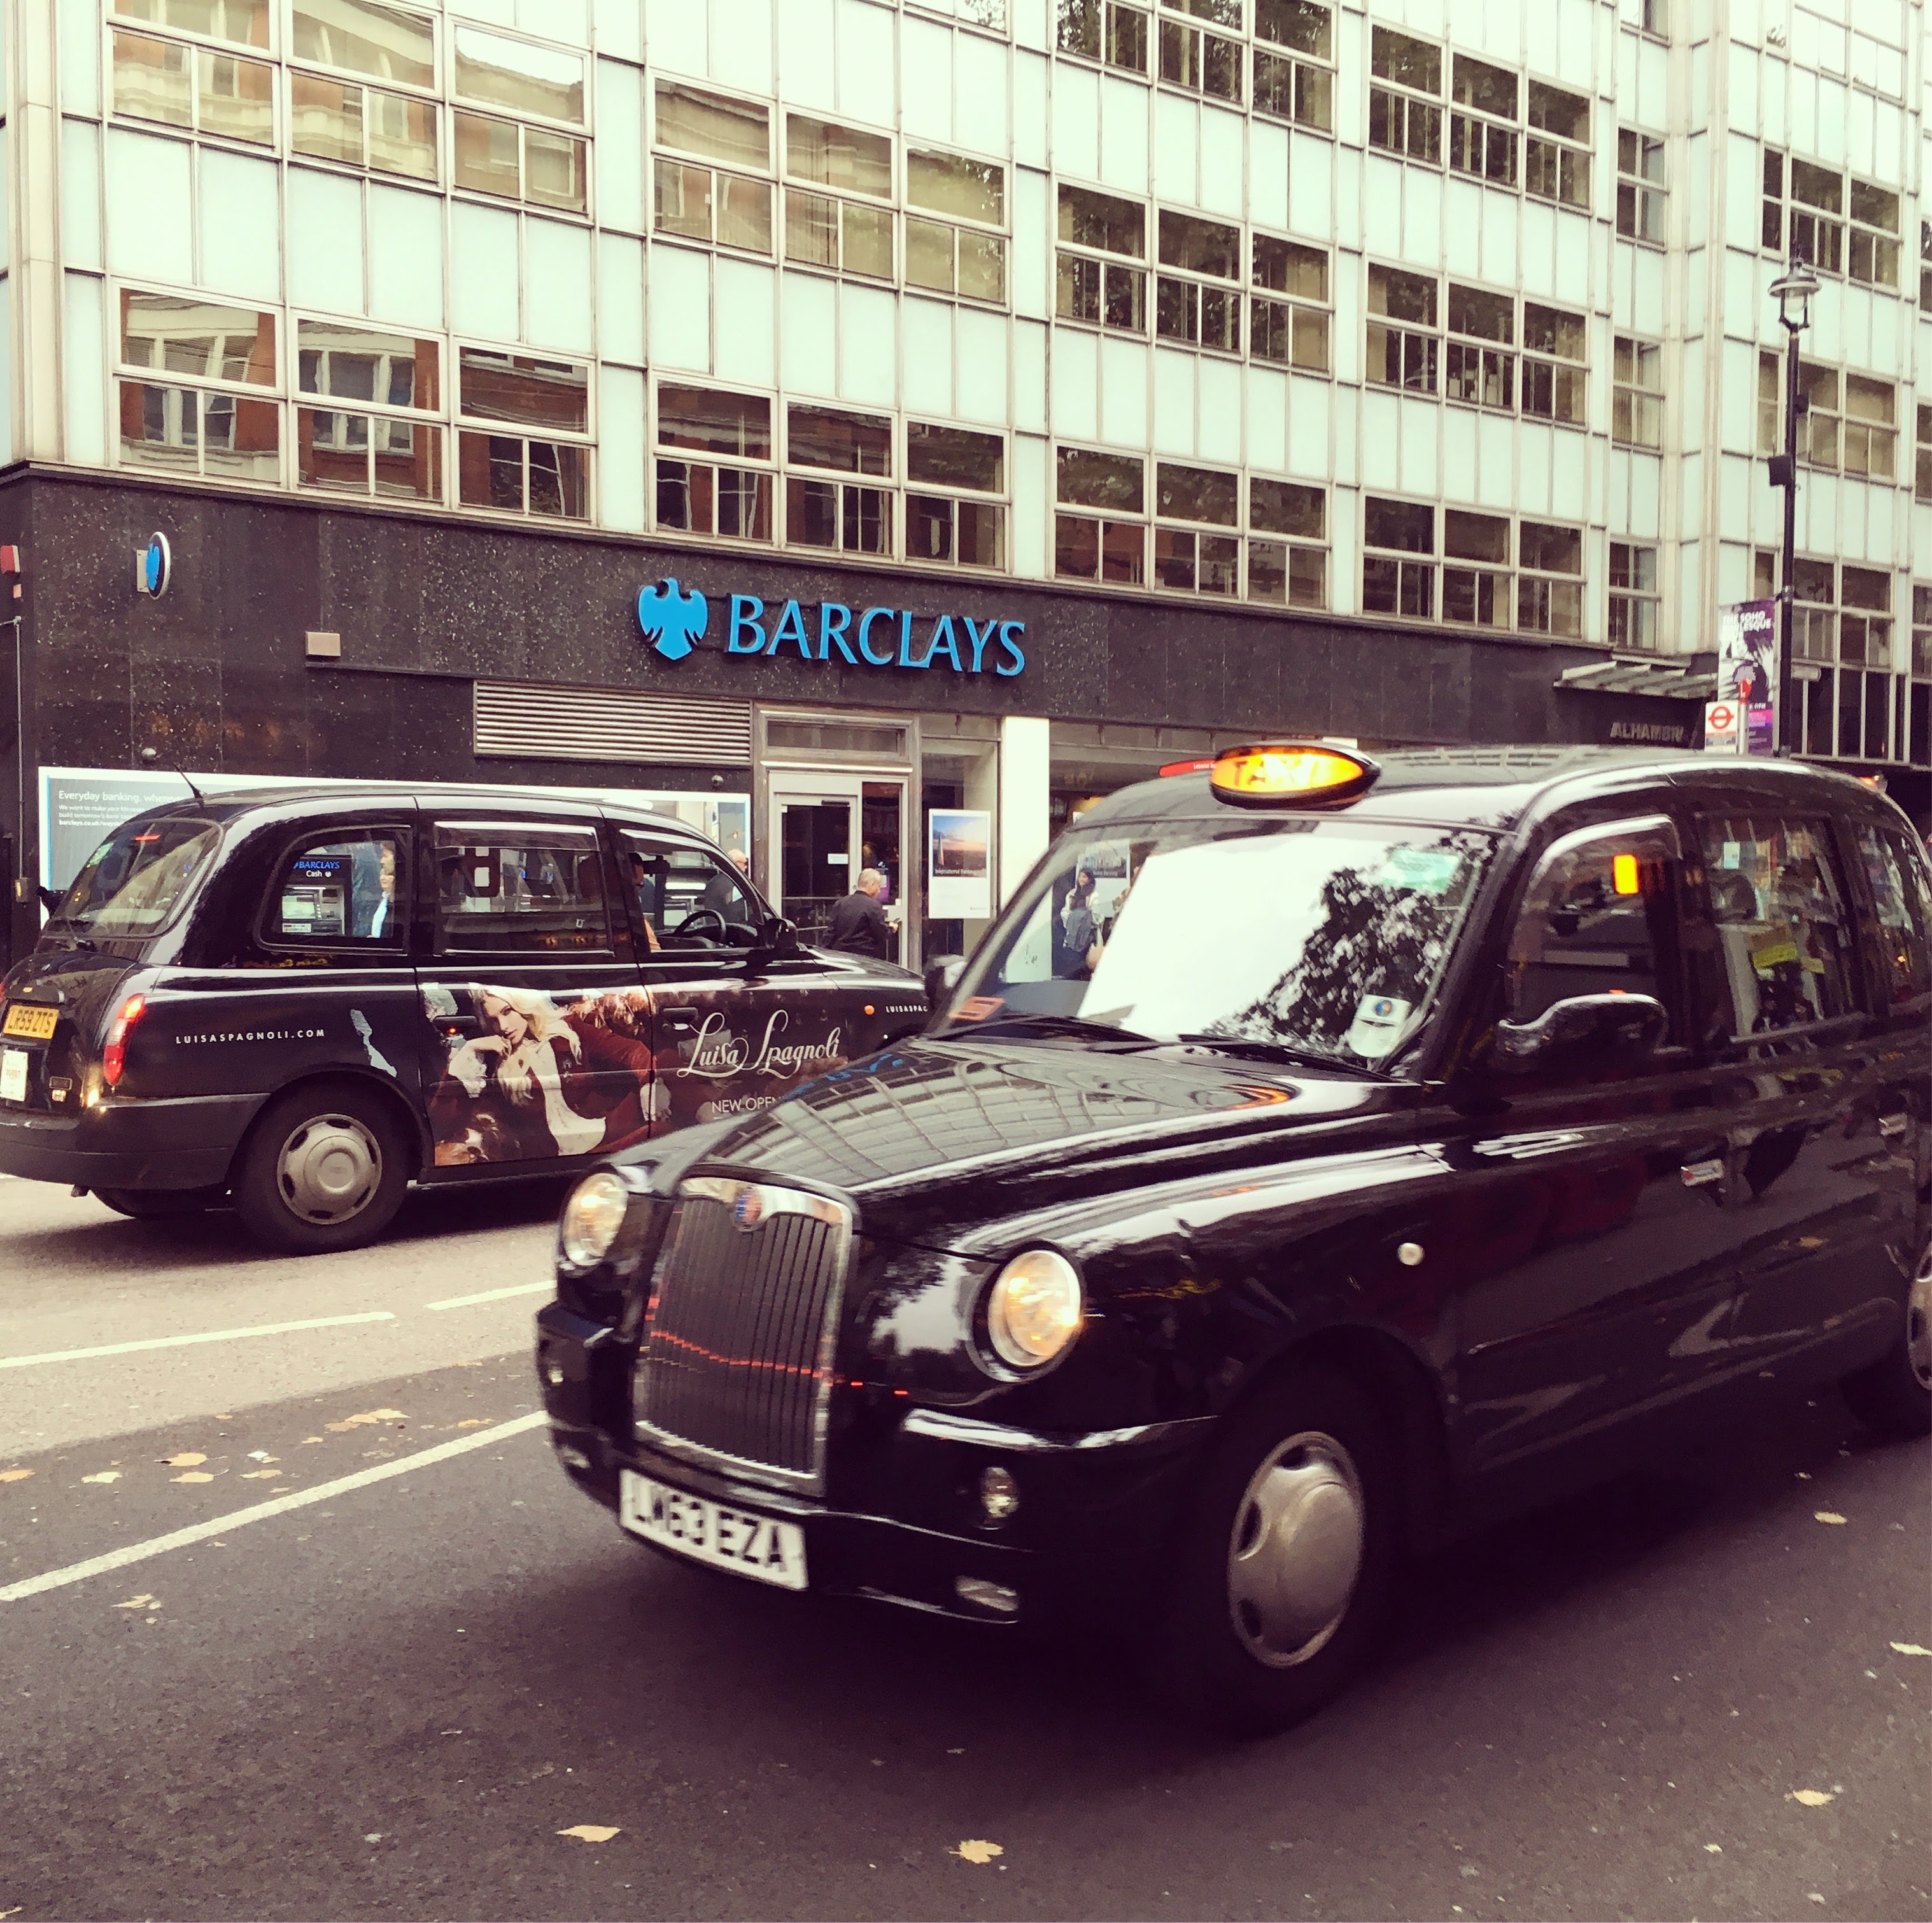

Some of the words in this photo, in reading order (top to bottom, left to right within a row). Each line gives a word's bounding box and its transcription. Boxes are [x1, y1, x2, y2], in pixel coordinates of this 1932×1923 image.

[1740, 610, 1766, 623] SOHO
[728, 593, 1025, 677] BARCLAYS
[1232, 757, 1321, 787] TAXI
[59, 790, 100, 802] Everyday
[102, 791, 141, 804] banking,
[299, 861, 341, 870] BARCLAYS
[306, 870, 323, 878] Cash
[32, 1011, 53, 1034] ZTS
[176, 1029, 325, 1045] LUISASPAGNOLI.COM
[676, 1011, 750, 1078] Luisa
[746, 1009, 842, 1080] Spagnoli
[712, 1099, 742, 1114] NEW
[716, 1506, 788, 1574] EZA
